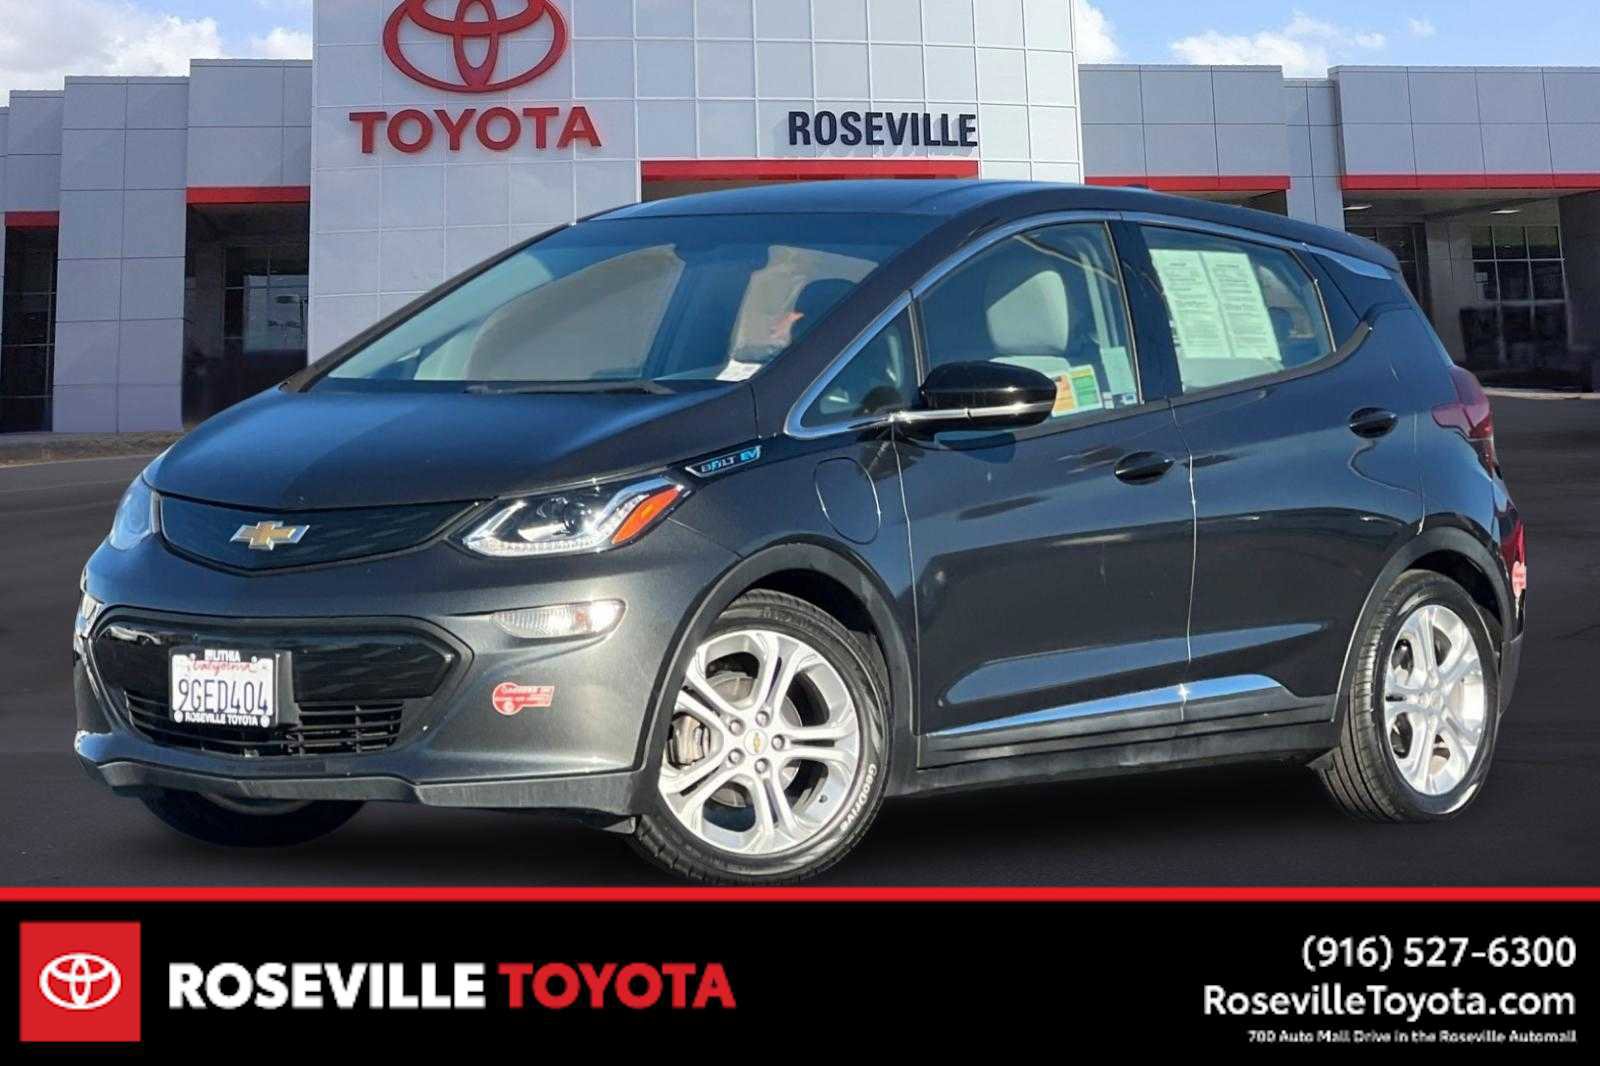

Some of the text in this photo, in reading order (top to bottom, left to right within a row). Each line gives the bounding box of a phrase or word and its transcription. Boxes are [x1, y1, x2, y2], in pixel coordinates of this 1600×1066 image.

[350, 105, 602, 154] TOYOTA
[788, 110, 979, 147] ROSEVILLE
[701, 448, 757, 472] BOLT EV
[178, 677, 268, 715] 9GED404
[186, 714, 258, 726] ROSEVILLE TOYOTA
